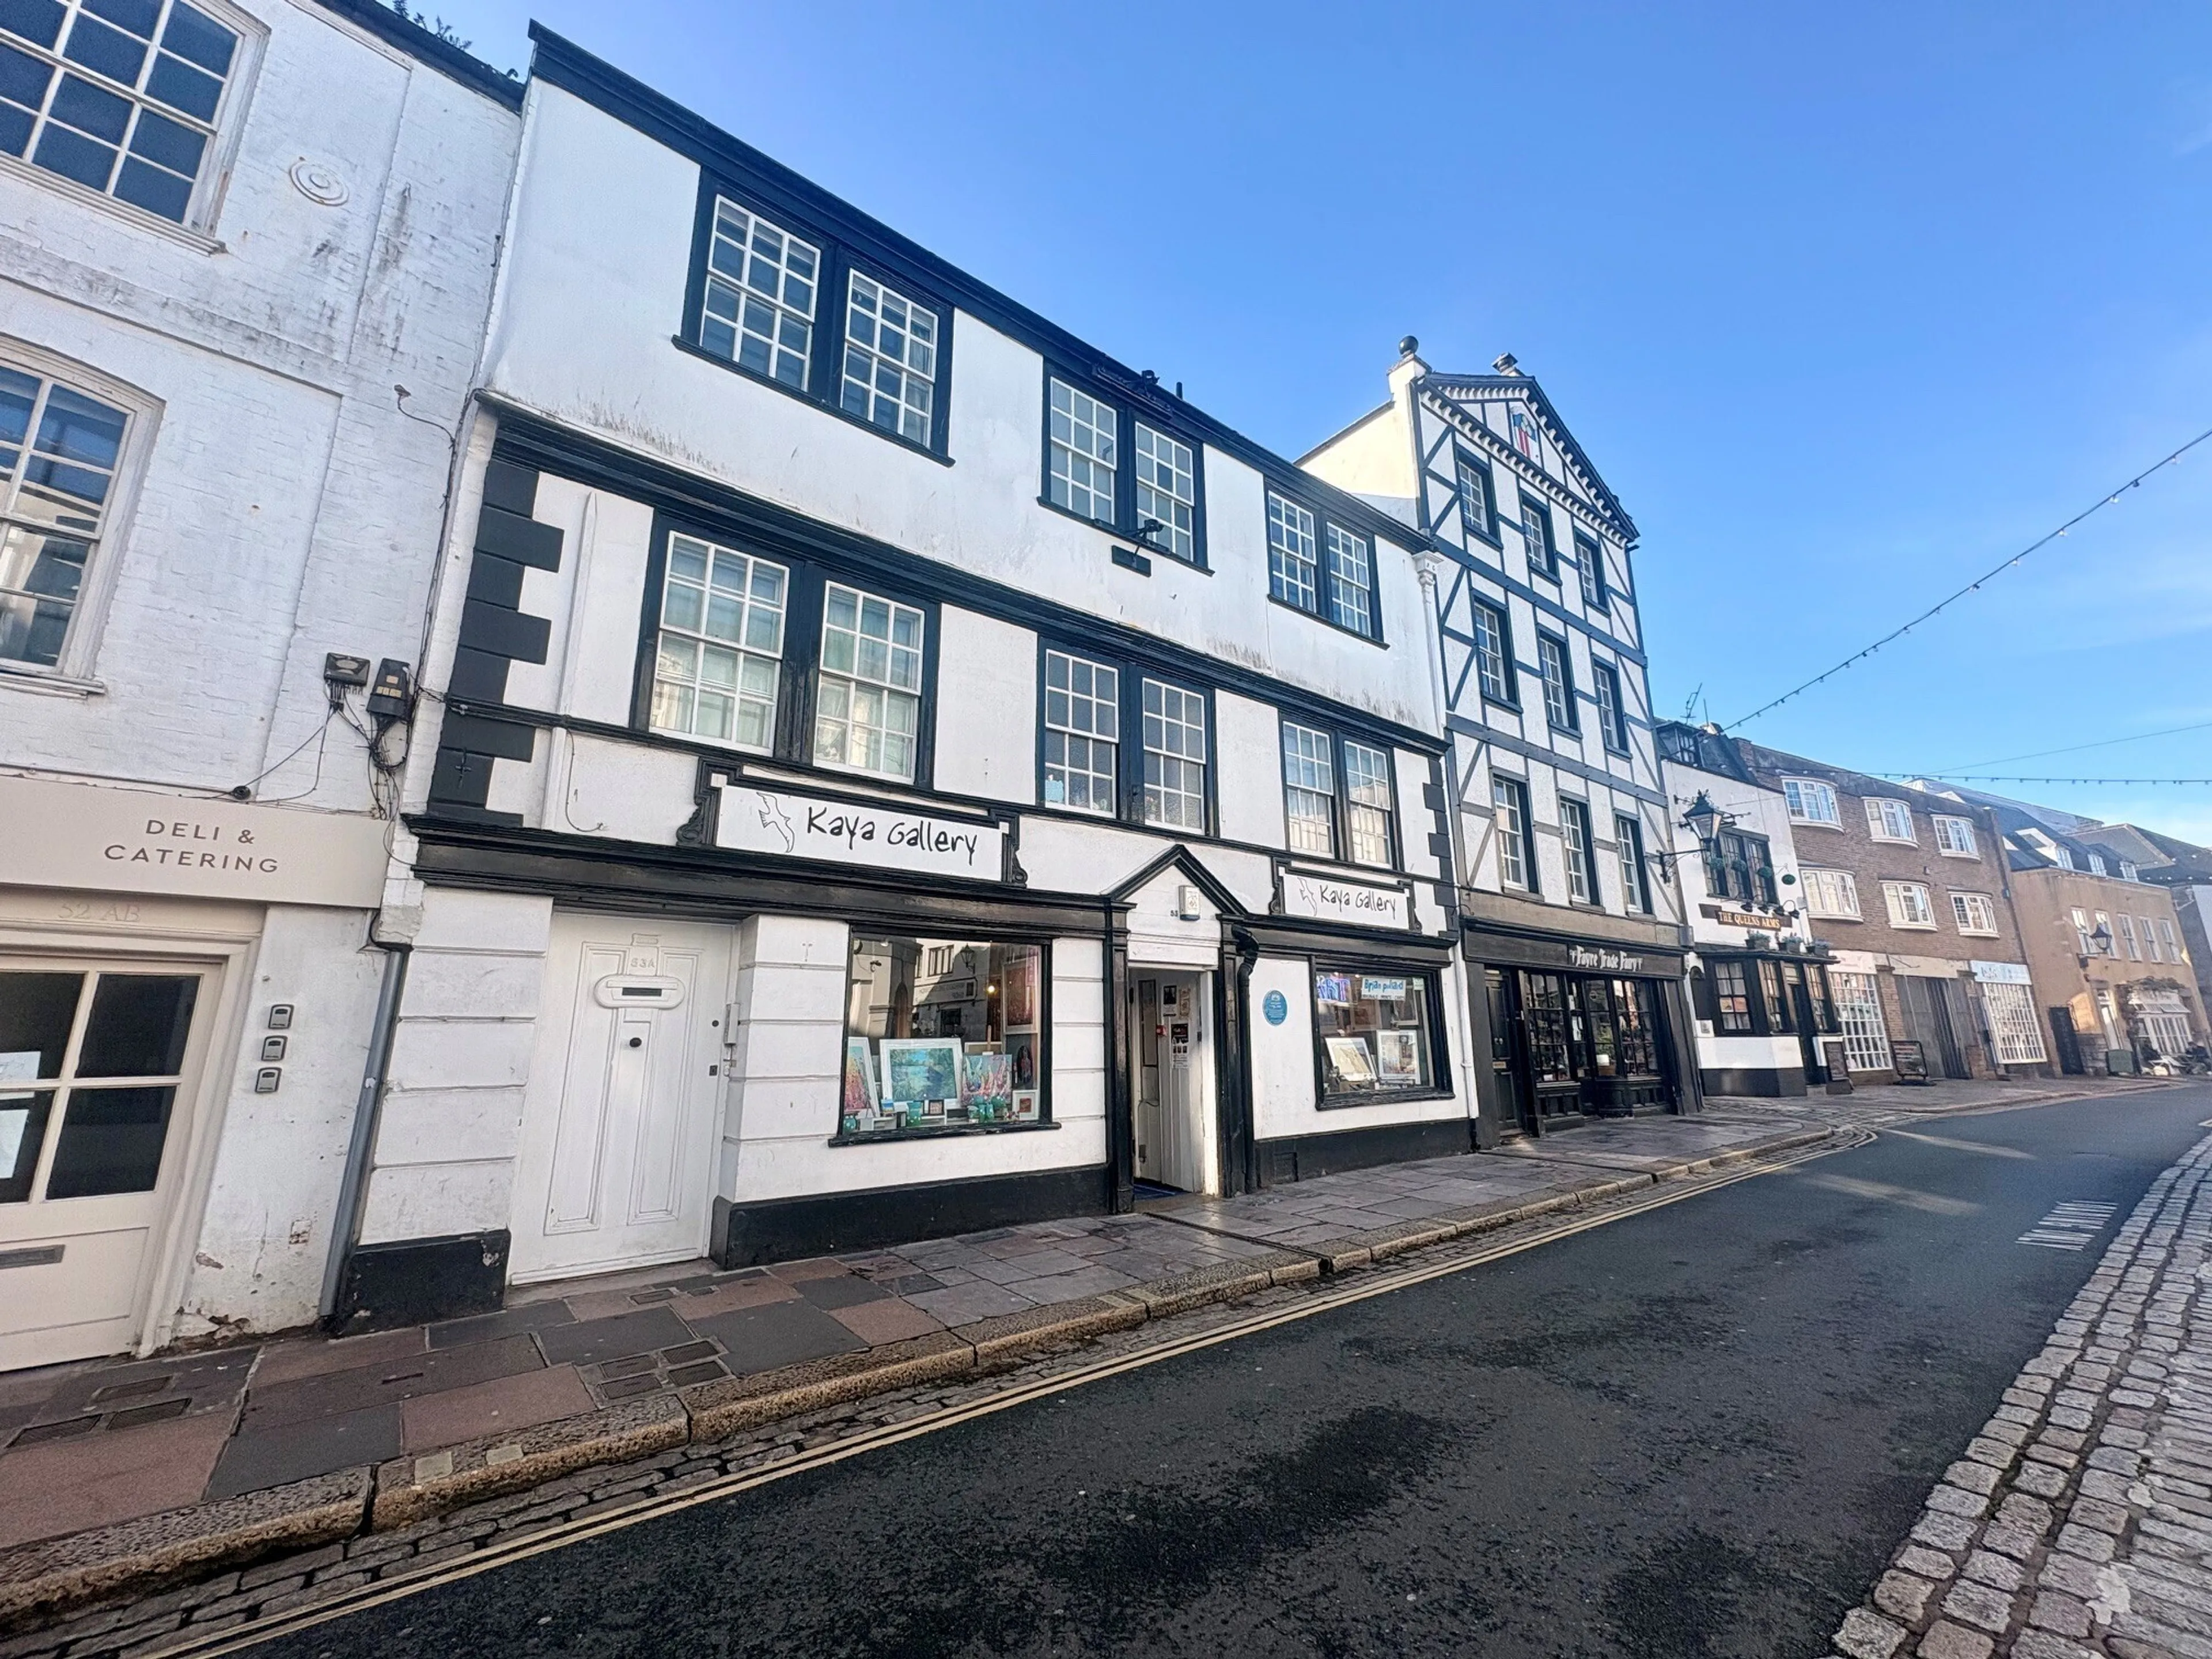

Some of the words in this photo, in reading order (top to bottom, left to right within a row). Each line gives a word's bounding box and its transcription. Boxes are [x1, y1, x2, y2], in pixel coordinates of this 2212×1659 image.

[146, 820, 219, 840] DELI
[238, 829, 255, 844] &
[808, 806, 875, 850] Kaya
[887, 820, 978, 866] Gallery
[104, 844, 278, 873] CATERING
[1320, 885, 1350, 912] Kaya
[1355, 891, 1396, 920] Gallery
[1718, 912, 1733, 922] THE
[1734, 914, 1760, 926] QUEENS
[1762, 917, 1781, 929] ARMS
